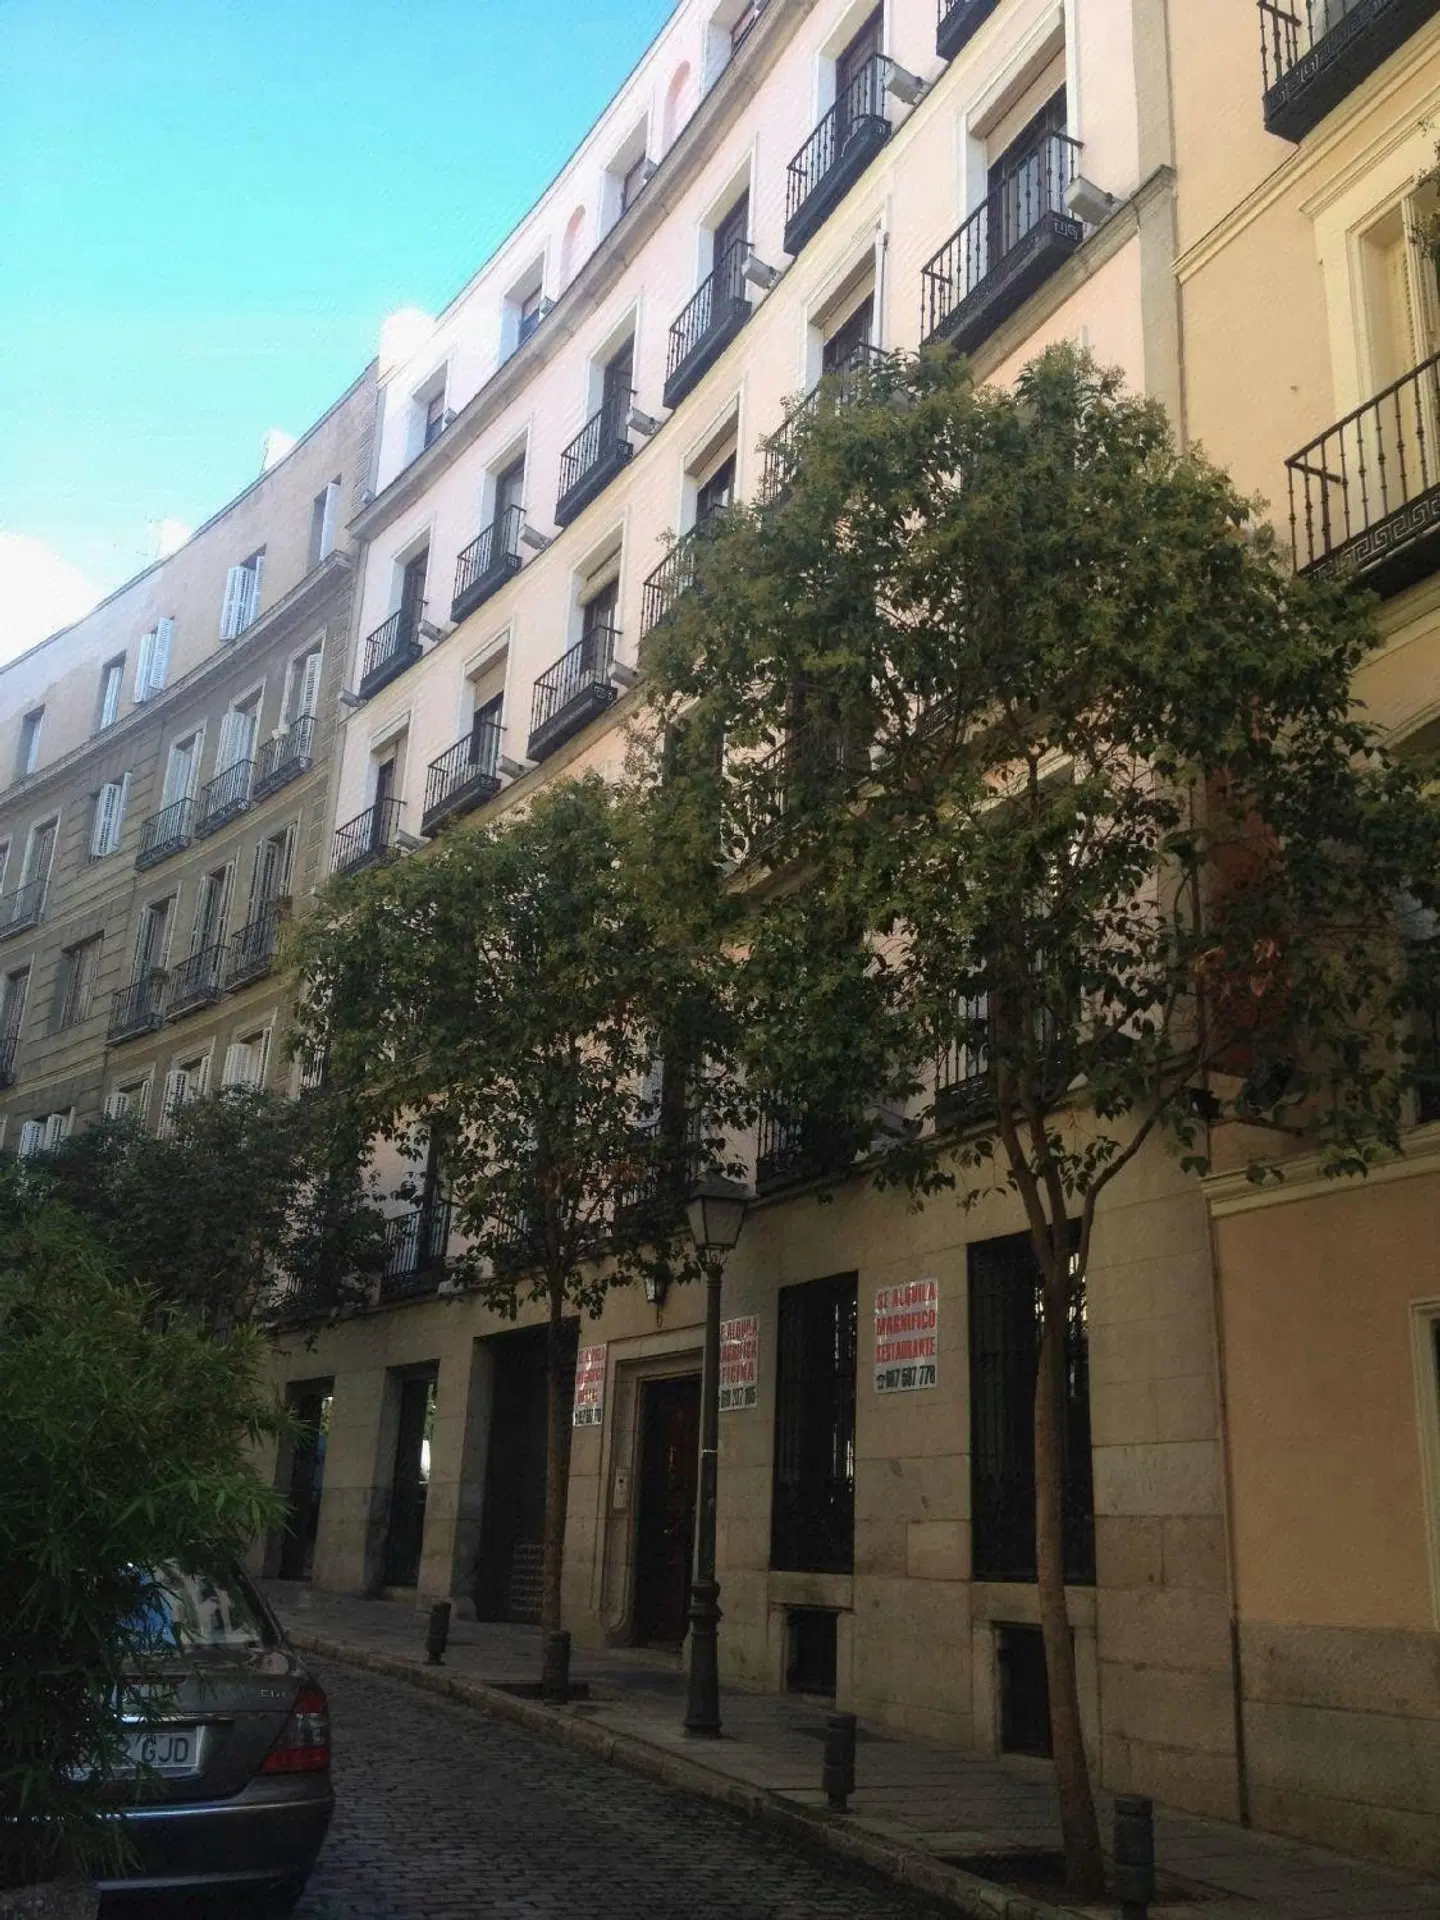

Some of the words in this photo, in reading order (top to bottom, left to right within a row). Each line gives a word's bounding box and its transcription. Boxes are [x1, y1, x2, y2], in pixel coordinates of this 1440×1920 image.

[892, 1282, 936, 1307] ALQUILA
[876, 1310, 936, 1336] MAGNIFICO
[876, 1337, 936, 1362] RESTAURANTE
[141, 1737, 189, 1763] GJD
